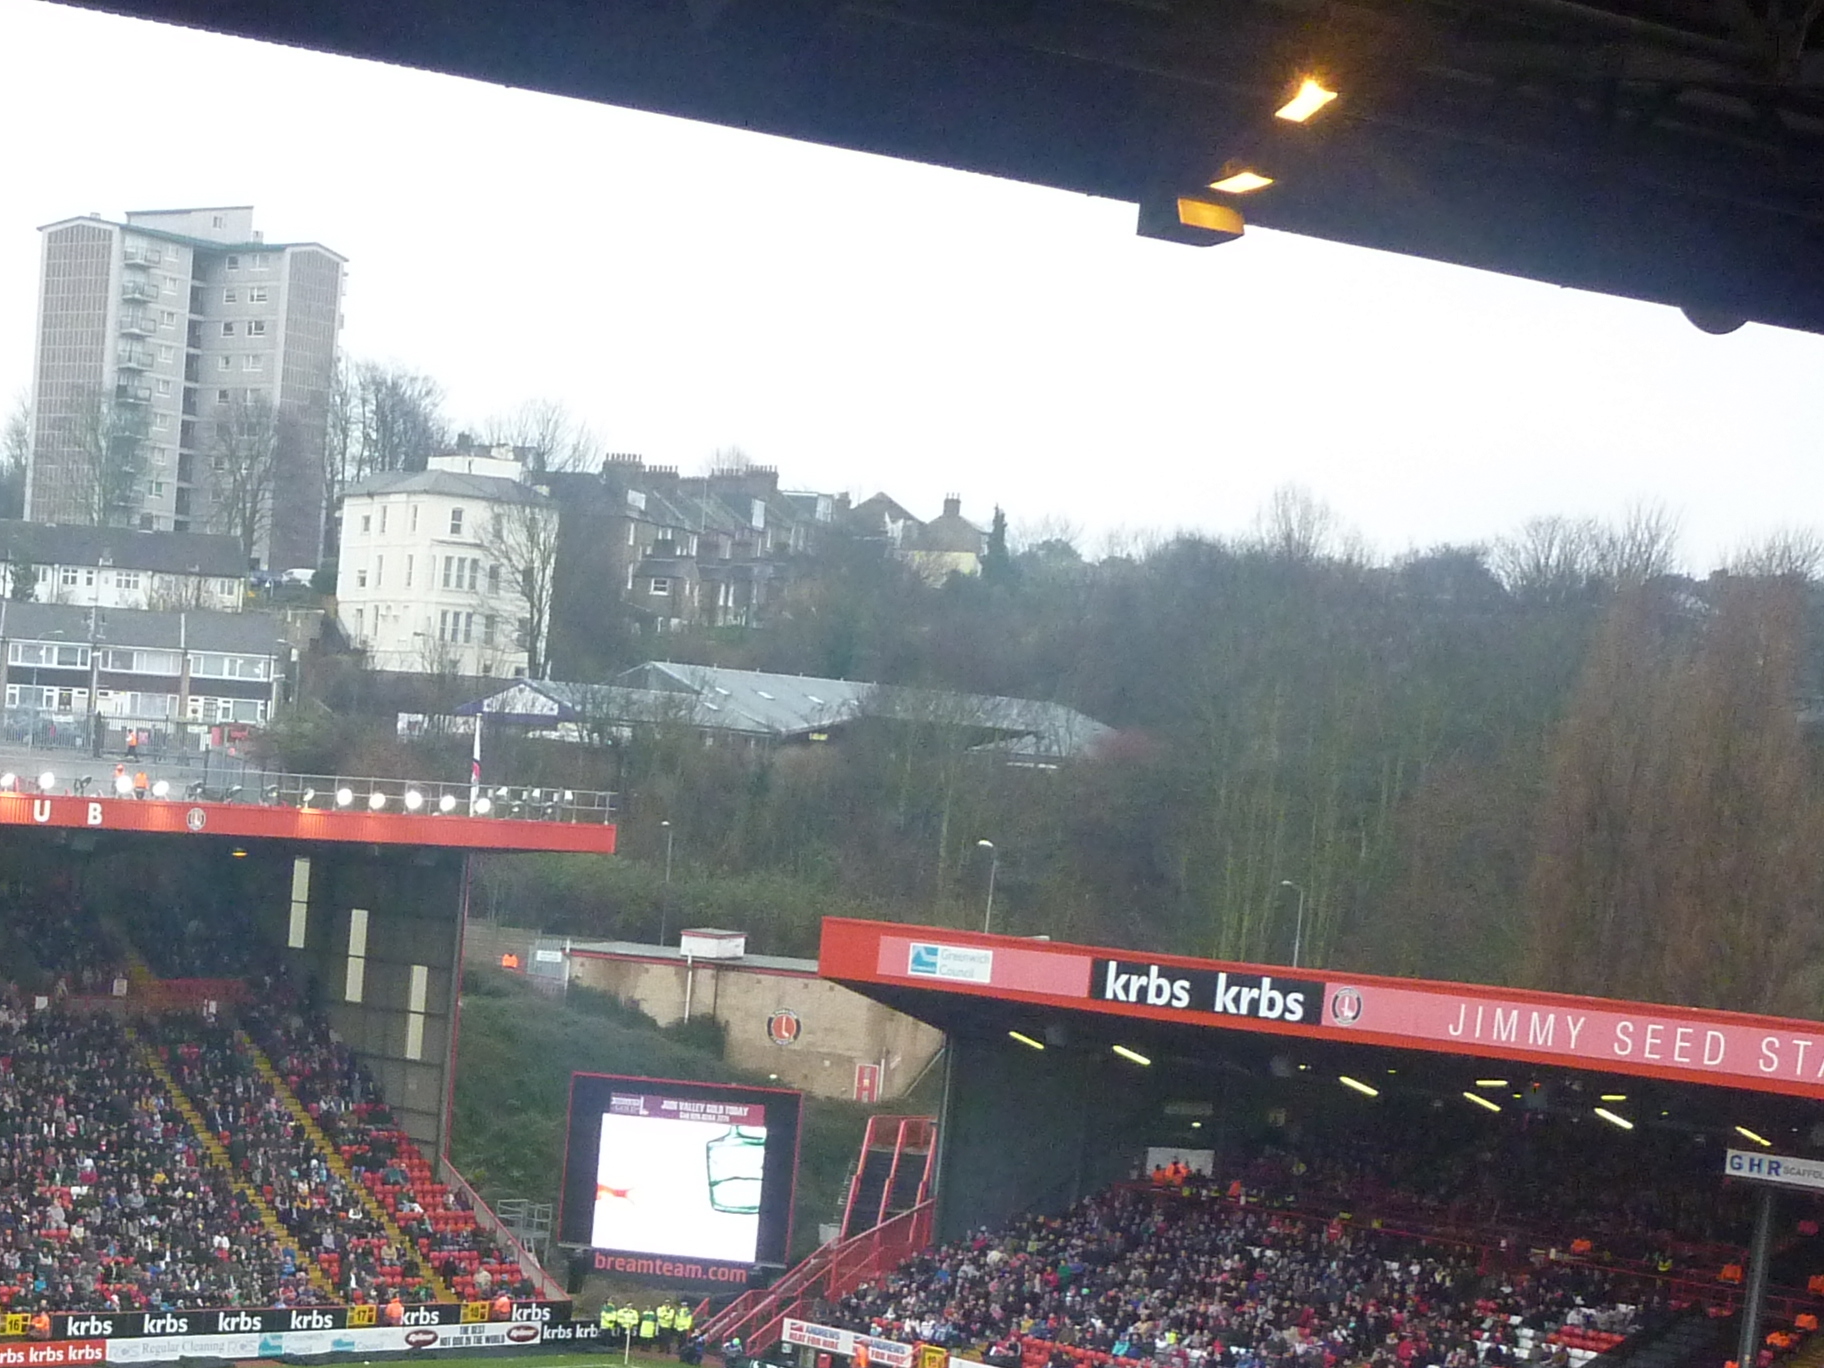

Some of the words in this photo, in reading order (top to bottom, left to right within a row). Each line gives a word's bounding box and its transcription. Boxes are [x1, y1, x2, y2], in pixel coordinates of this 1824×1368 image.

[1105, 960, 1191, 1008] krbs
[1214, 972, 1305, 1022] krbs
[1448, 1003, 1586, 1049] JIMMY
[1613, 1021, 1726, 1066] SEED
[594, 1252, 747, 1284] breamteam.com
[357, 1310, 367, 1322] 17
[400, 1305, 439, 1326] krbs
[511, 1302, 551, 1322] krbs
[8, 1319, 19, 1333] 16
[66, 1315, 113, 1337] krbs
[143, 1312, 189, 1335] krbs
[218, 1311, 262, 1333] krbs
[290, 1309, 333, 1330] krbs
[543, 1324, 572, 1340] krbs
[29, 1345, 65, 1363] krbs
[68, 1343, 102, 1361] krbs
